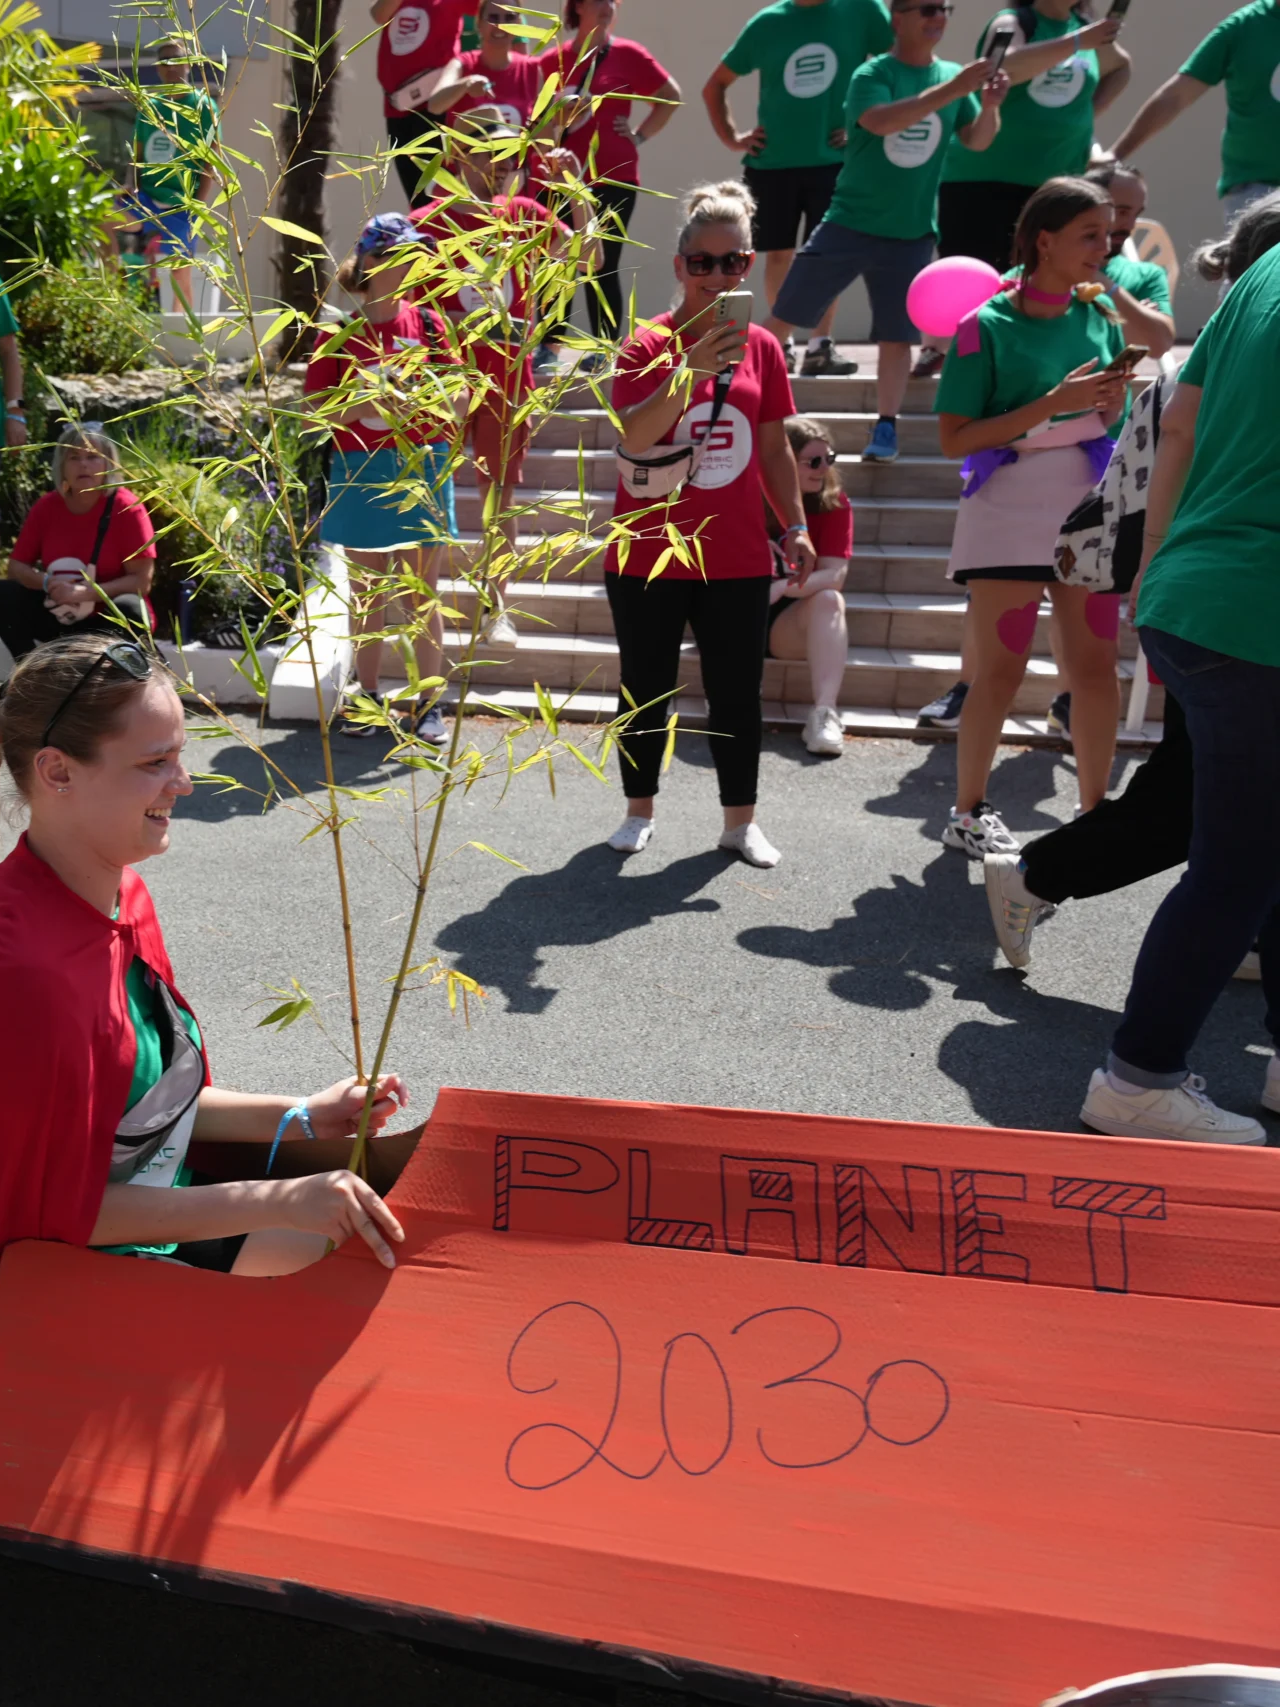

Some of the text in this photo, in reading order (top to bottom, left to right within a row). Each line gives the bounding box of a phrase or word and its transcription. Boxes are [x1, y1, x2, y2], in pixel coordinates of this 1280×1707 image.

[690, 420, 734, 451] S
[493, 1135, 1166, 1293] PLANET
[506, 1302, 950, 1490] 2030
